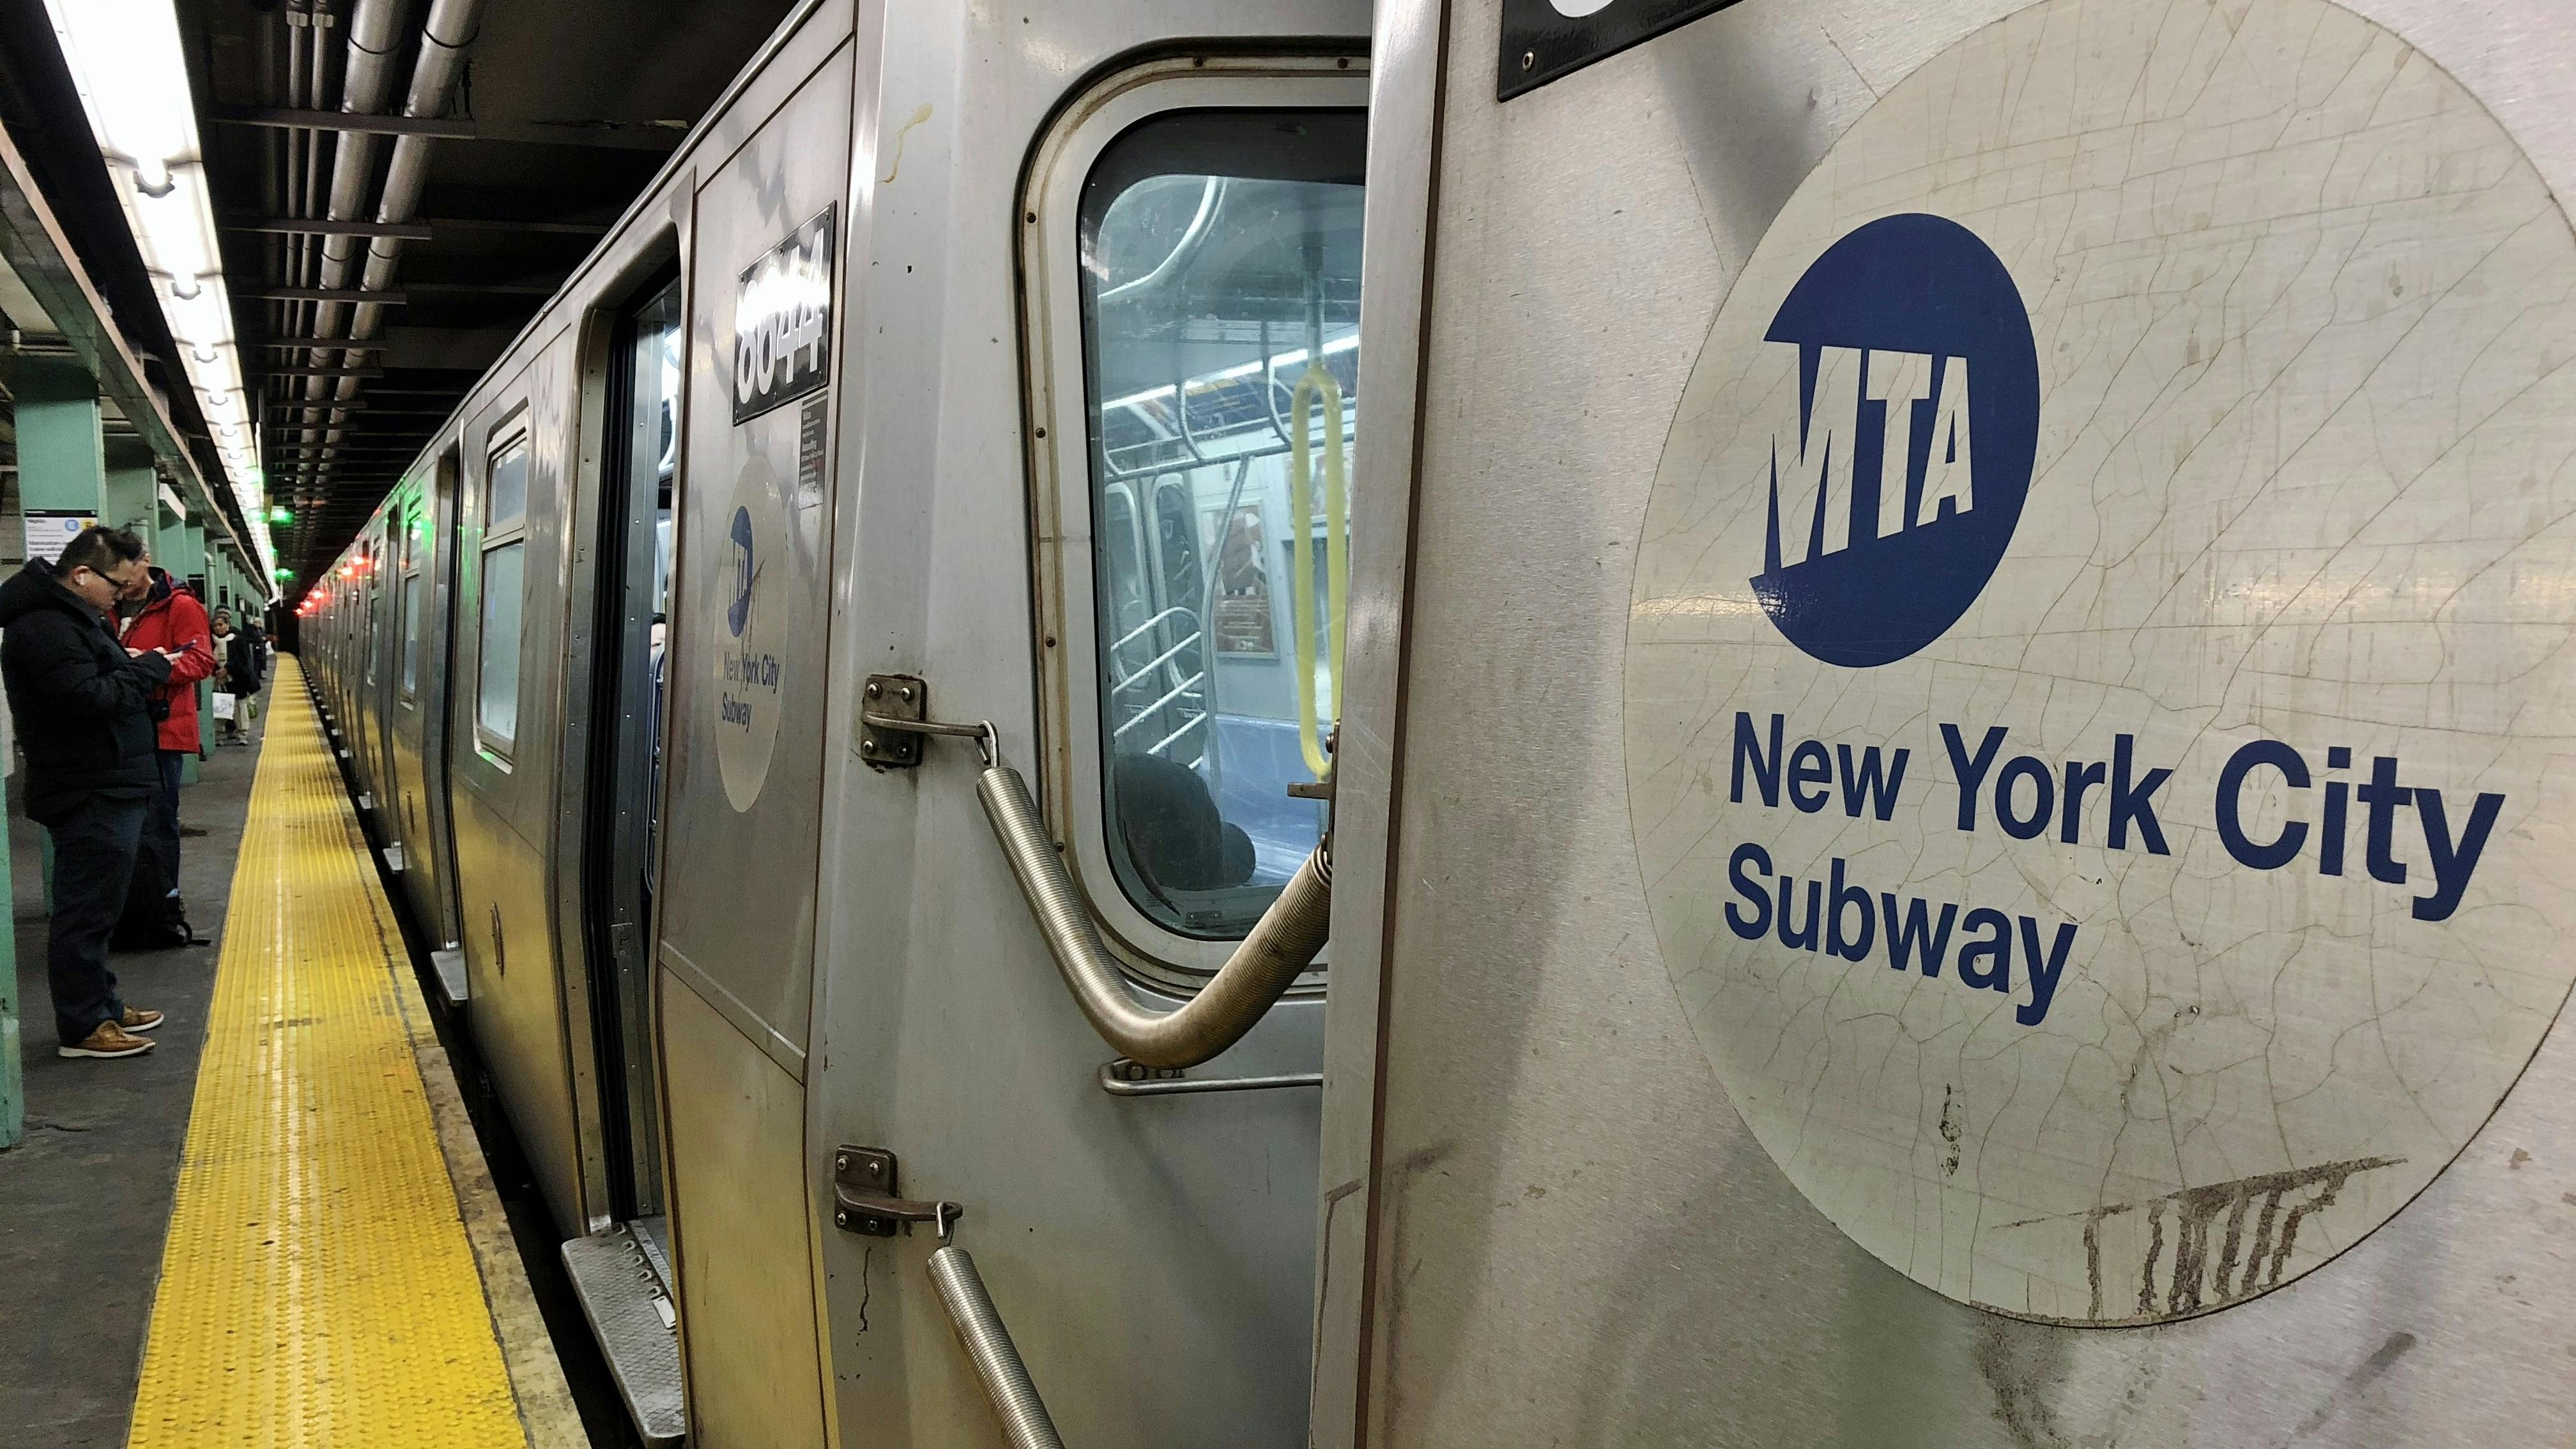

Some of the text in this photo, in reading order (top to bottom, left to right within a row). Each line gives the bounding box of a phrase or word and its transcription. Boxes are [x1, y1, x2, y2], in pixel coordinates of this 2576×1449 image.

[1762, 340, 1974, 569] MTA
[722, 691, 752, 733] Subway
[724, 652, 780, 694] New York City
[1731, 712, 2505, 923] New York City
[1724, 843, 2078, 1026] Subway
